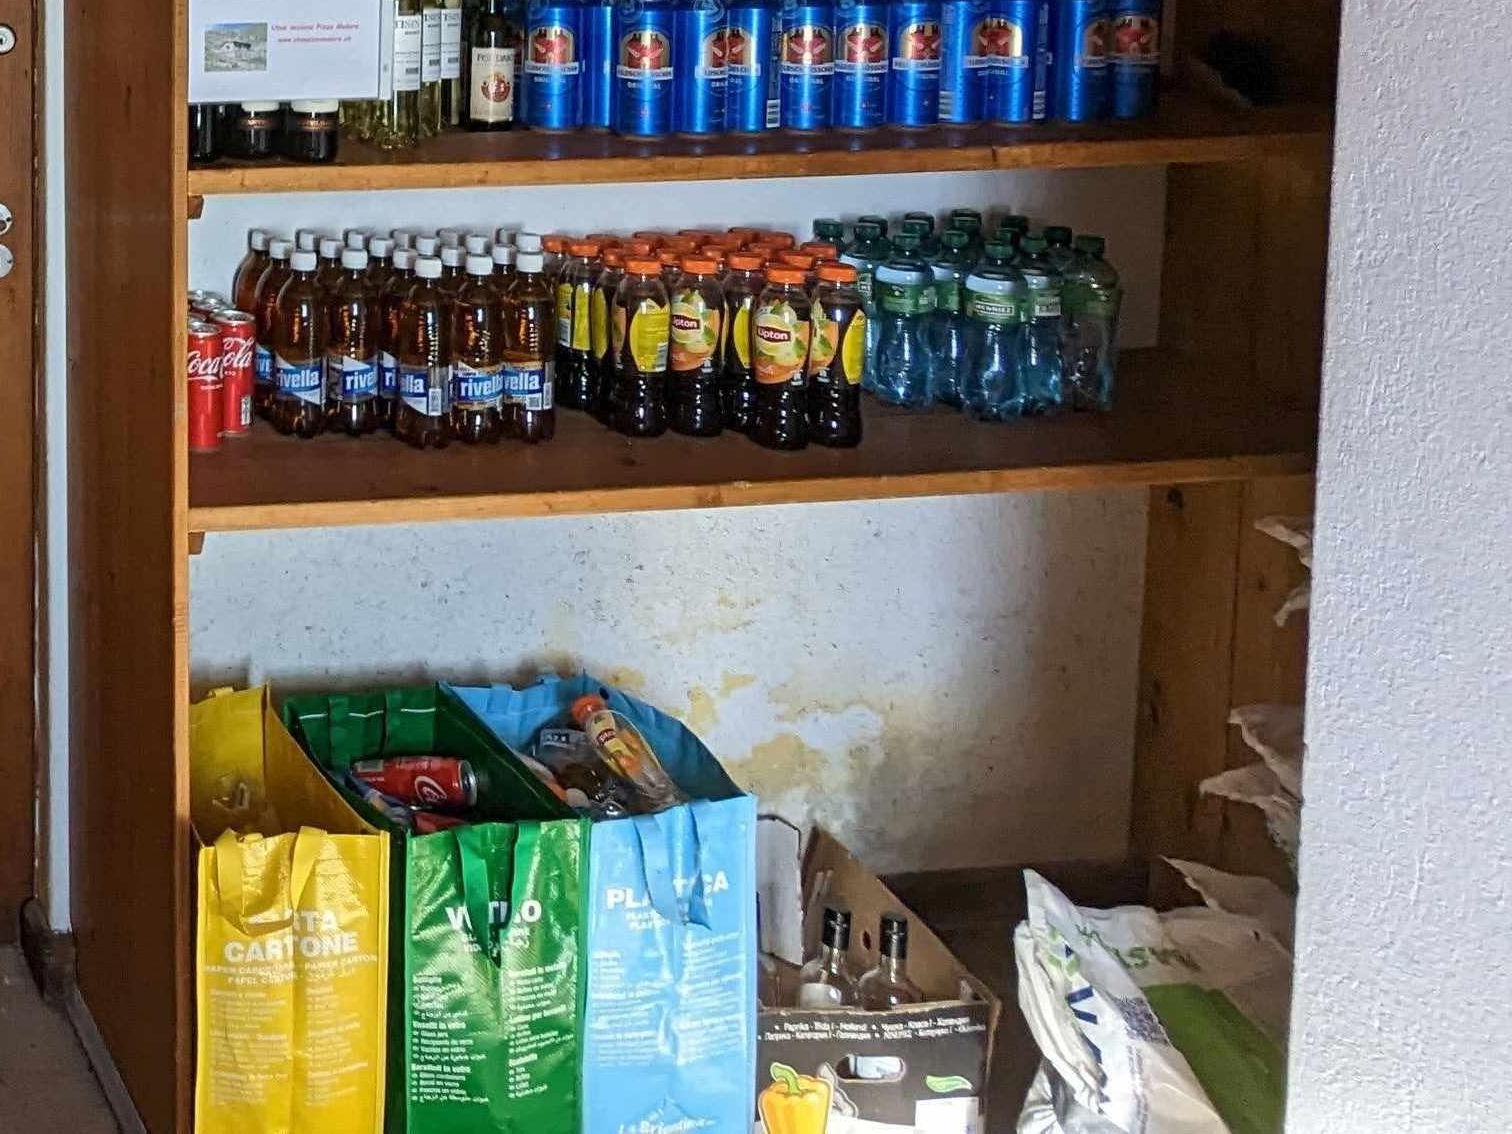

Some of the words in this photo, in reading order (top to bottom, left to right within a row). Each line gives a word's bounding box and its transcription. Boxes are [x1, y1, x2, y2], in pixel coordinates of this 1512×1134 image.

[672, 316, 698, 329] ipton
[758, 327, 789, 341] Lipton
[606, 870, 730, 910] PLTCA
[444, 899, 542, 931] VTO
[224, 930, 360, 964] CARTONE
